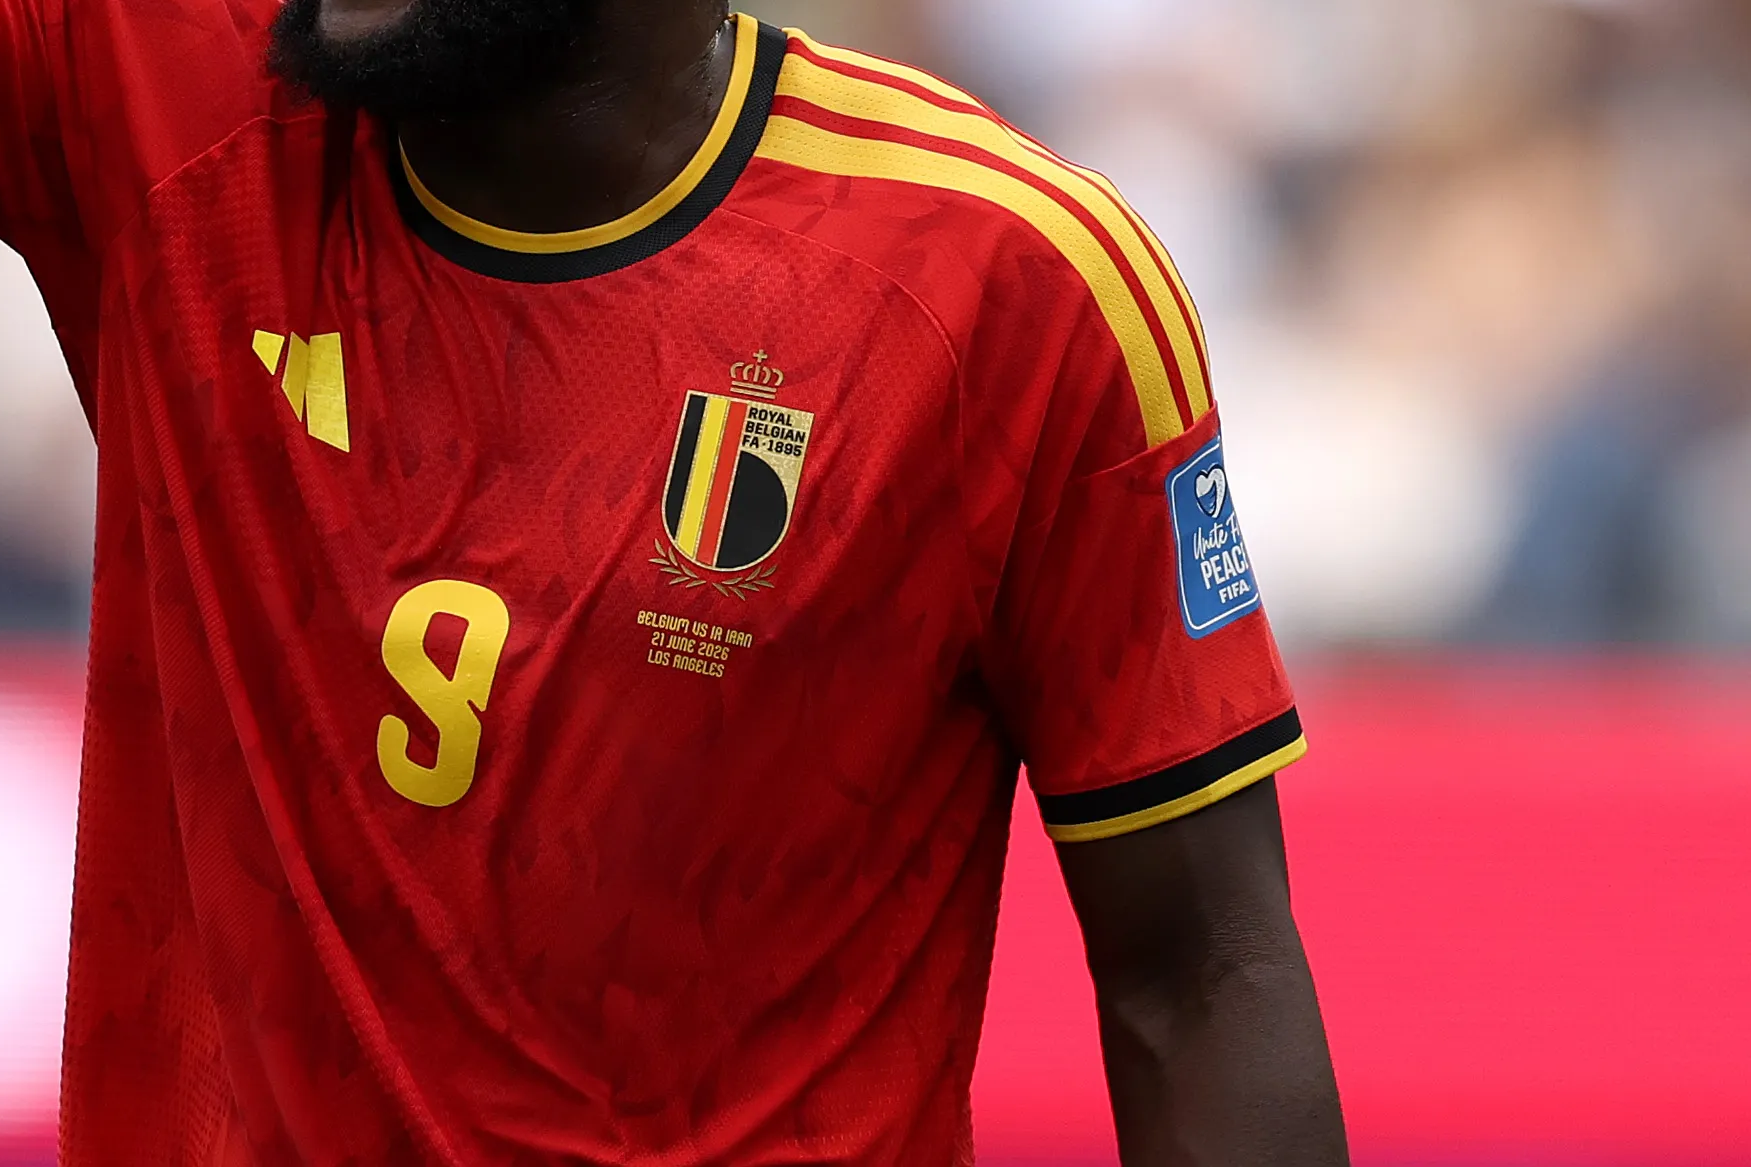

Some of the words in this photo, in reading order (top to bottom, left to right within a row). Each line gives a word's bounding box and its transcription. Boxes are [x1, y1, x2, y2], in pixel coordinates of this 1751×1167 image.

[745, 420, 806, 443] BELGIAN
[748, 407, 792, 427] ROYAL
[1193, 522, 1228, 560] Unite
[1218, 578, 1250, 604] FIFA
[637, 610, 690, 634] BELGIUM
[710, 625, 723, 641] IR
[725, 629, 753, 648] IRAN
[651, 631, 665, 647] 21
[666, 635, 696, 653] JUNE
[697, 642, 730, 661] 2026
[647, 649, 671, 666] LOS
[672, 654, 725, 678] ANGELES
